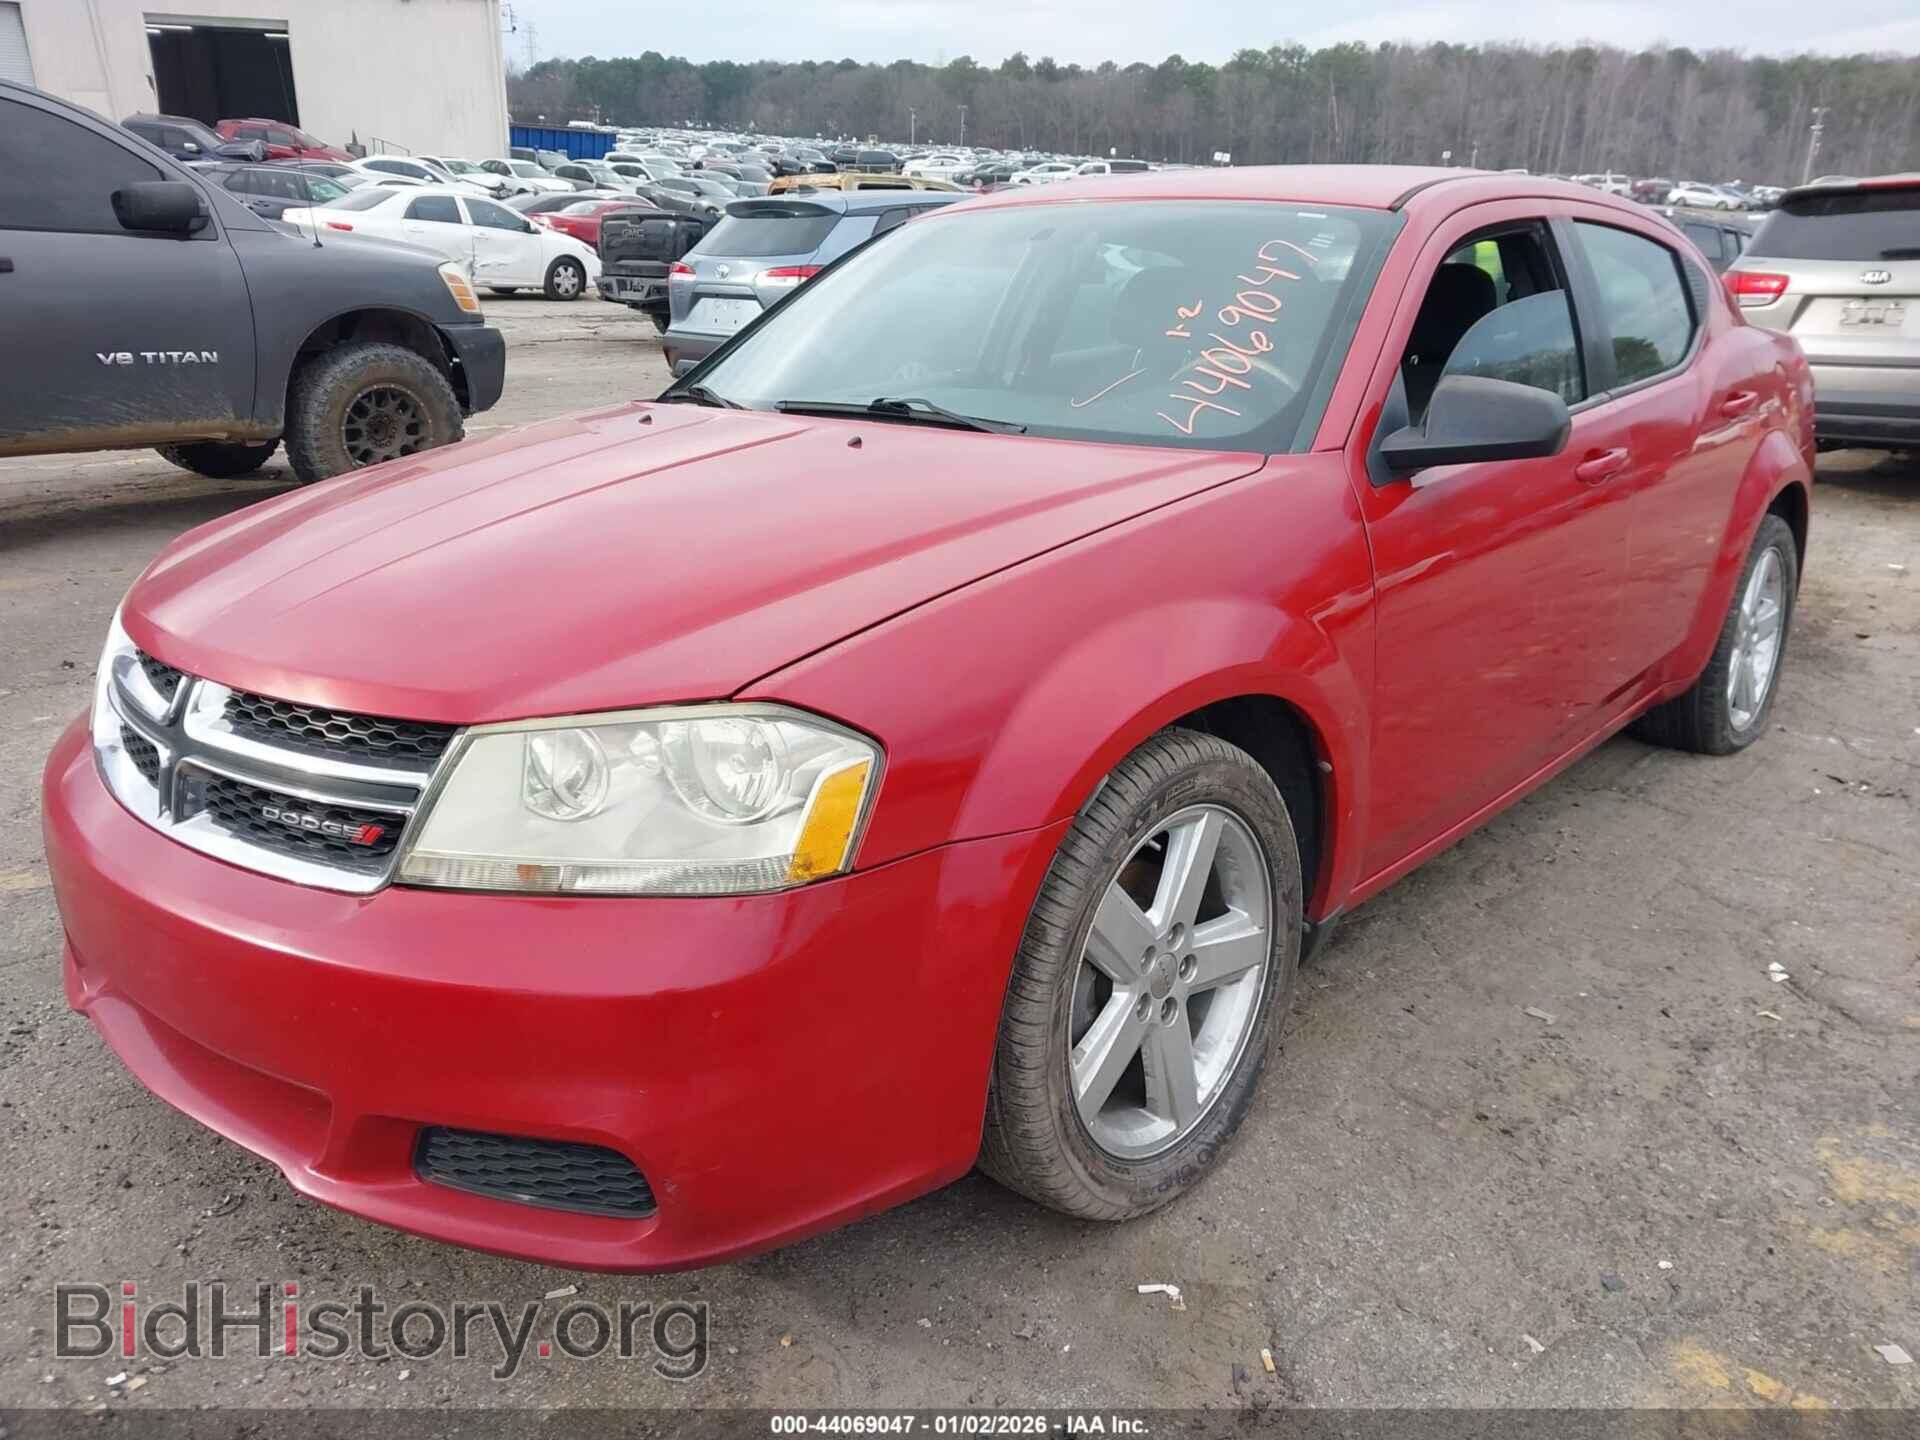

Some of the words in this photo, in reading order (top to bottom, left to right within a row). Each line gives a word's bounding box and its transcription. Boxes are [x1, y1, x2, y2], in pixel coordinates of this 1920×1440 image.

[1156, 239, 1319, 434] 44069047
[96, 351, 134, 365] V8
[140, 351, 219, 364] TITAN
[262, 805, 364, 840] DODGE
